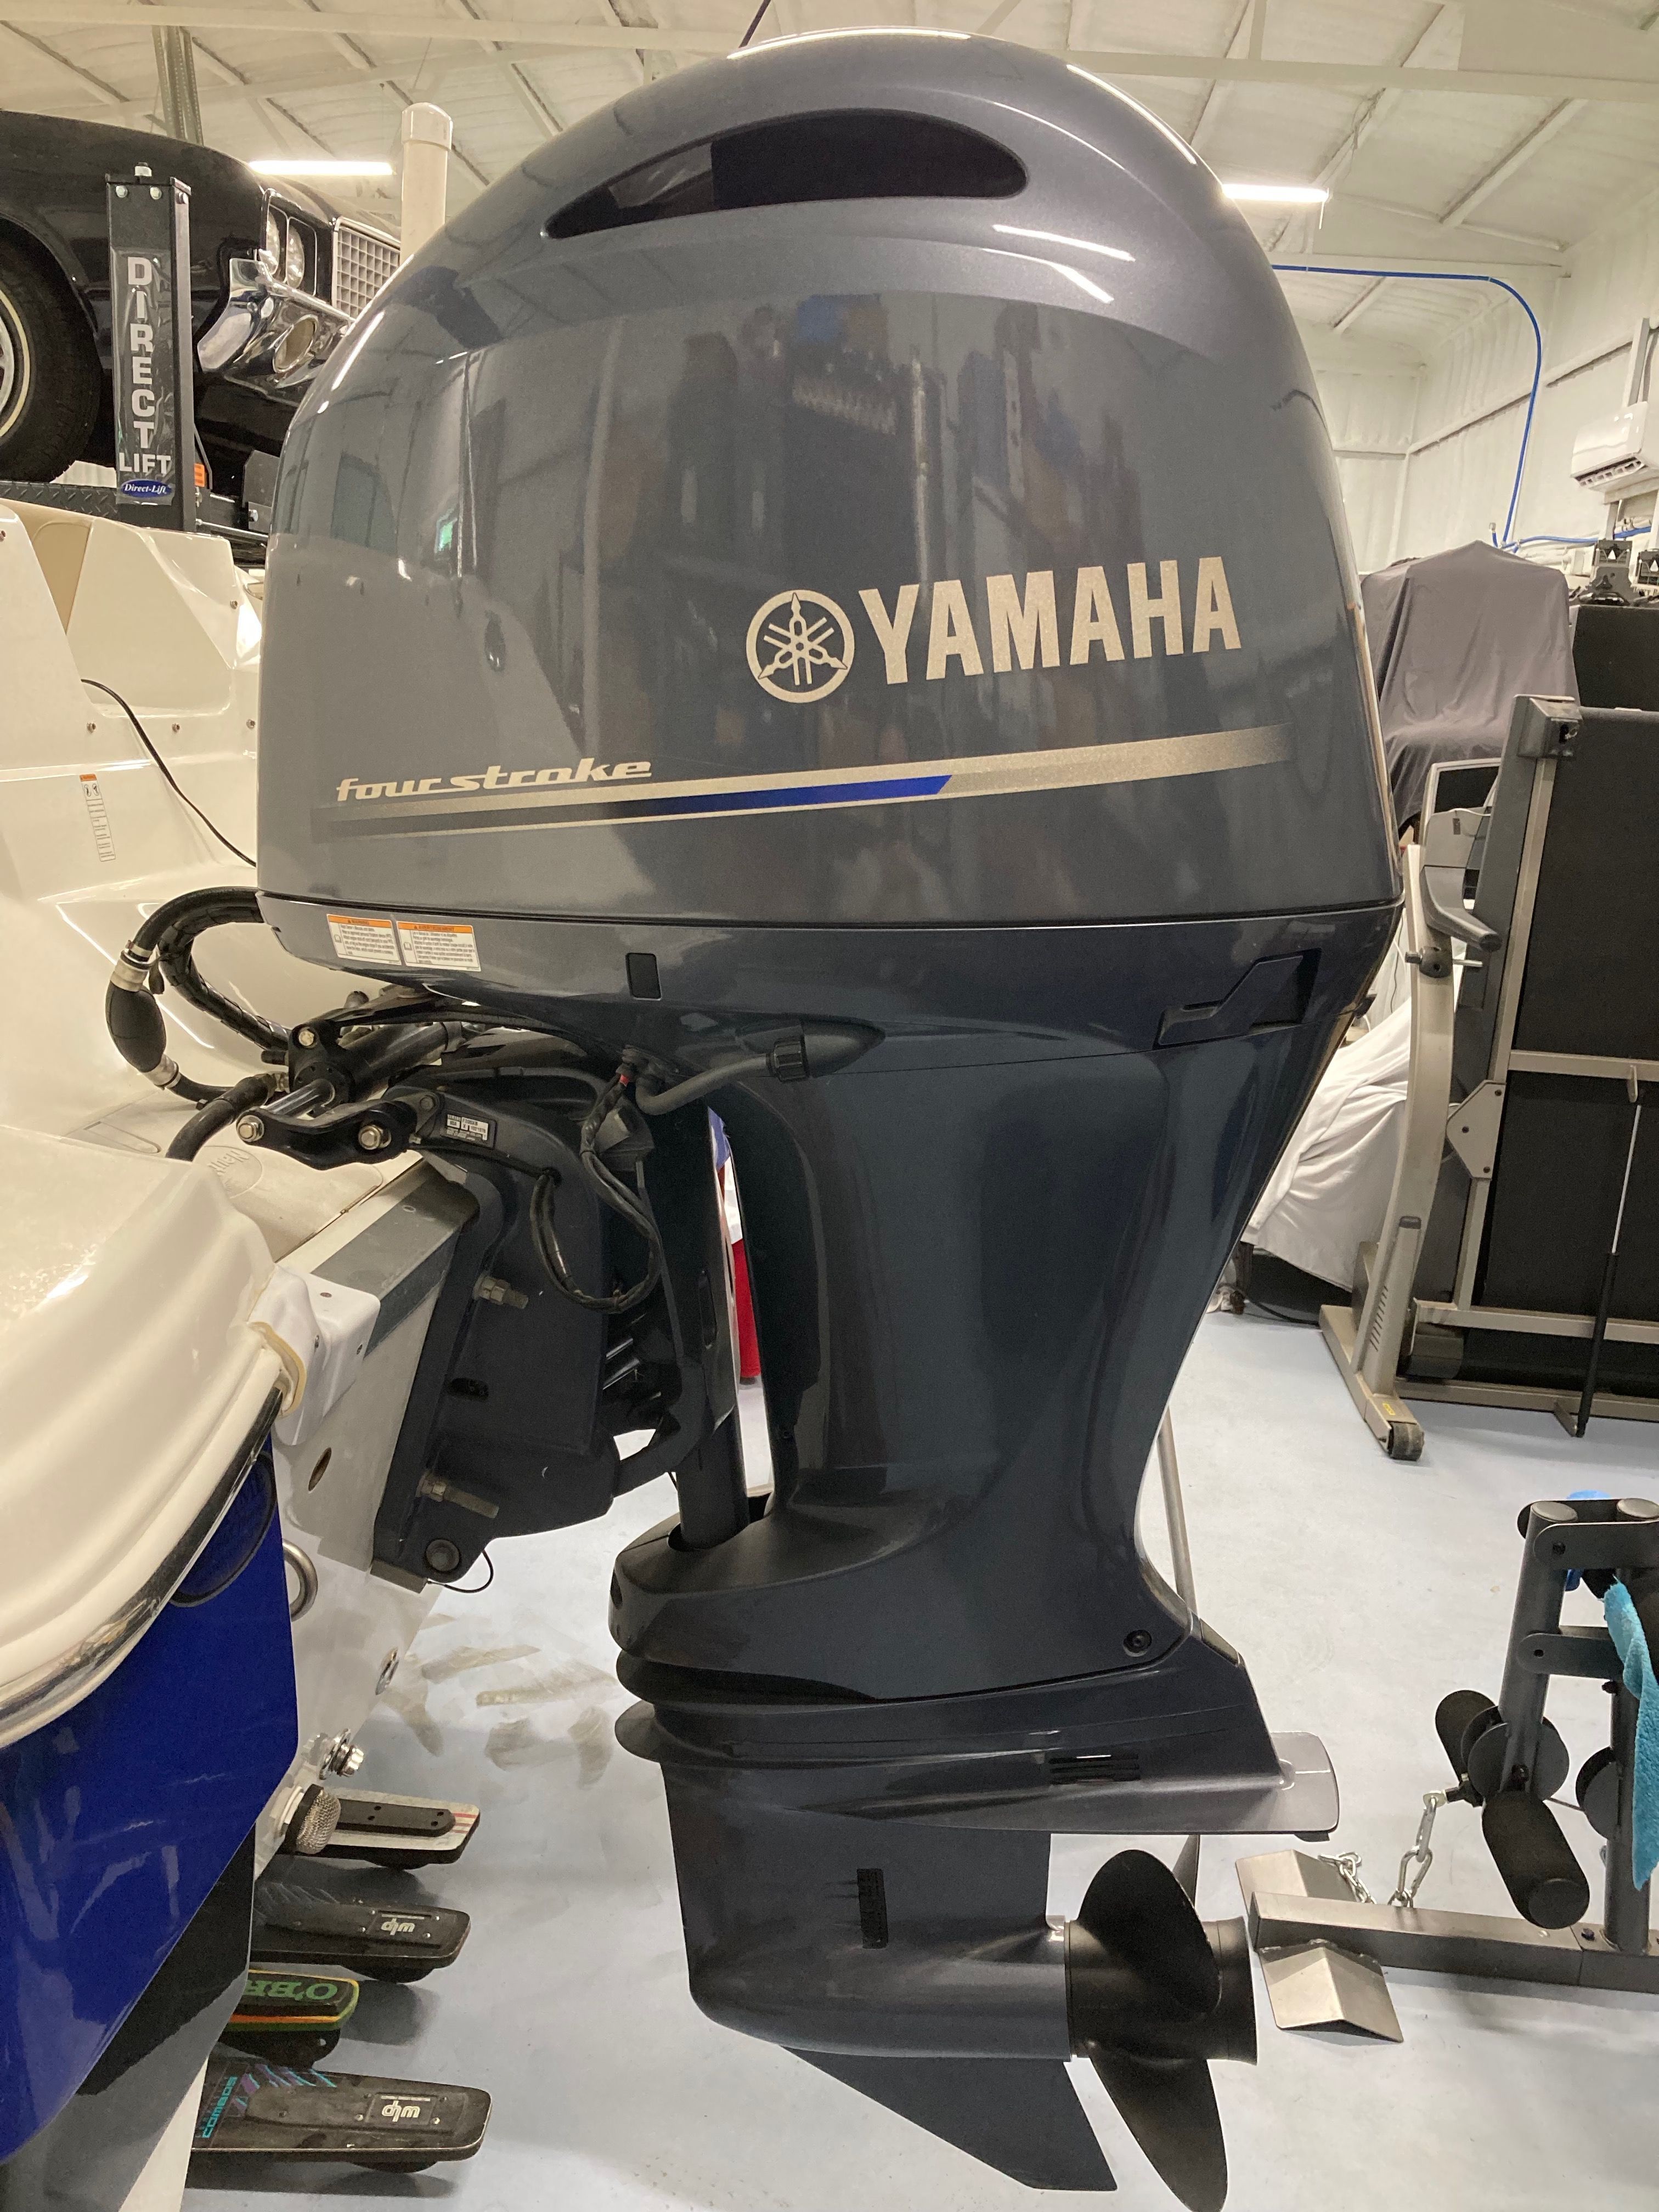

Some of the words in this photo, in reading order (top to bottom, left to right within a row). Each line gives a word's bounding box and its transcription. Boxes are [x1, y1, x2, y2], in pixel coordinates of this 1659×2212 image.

[127, 256, 155, 449] DIRECT
[119, 453, 171, 475] LIFT
[124, 483, 166, 494] Direct-Lift
[859, 556, 1241, 685] YAMAHA
